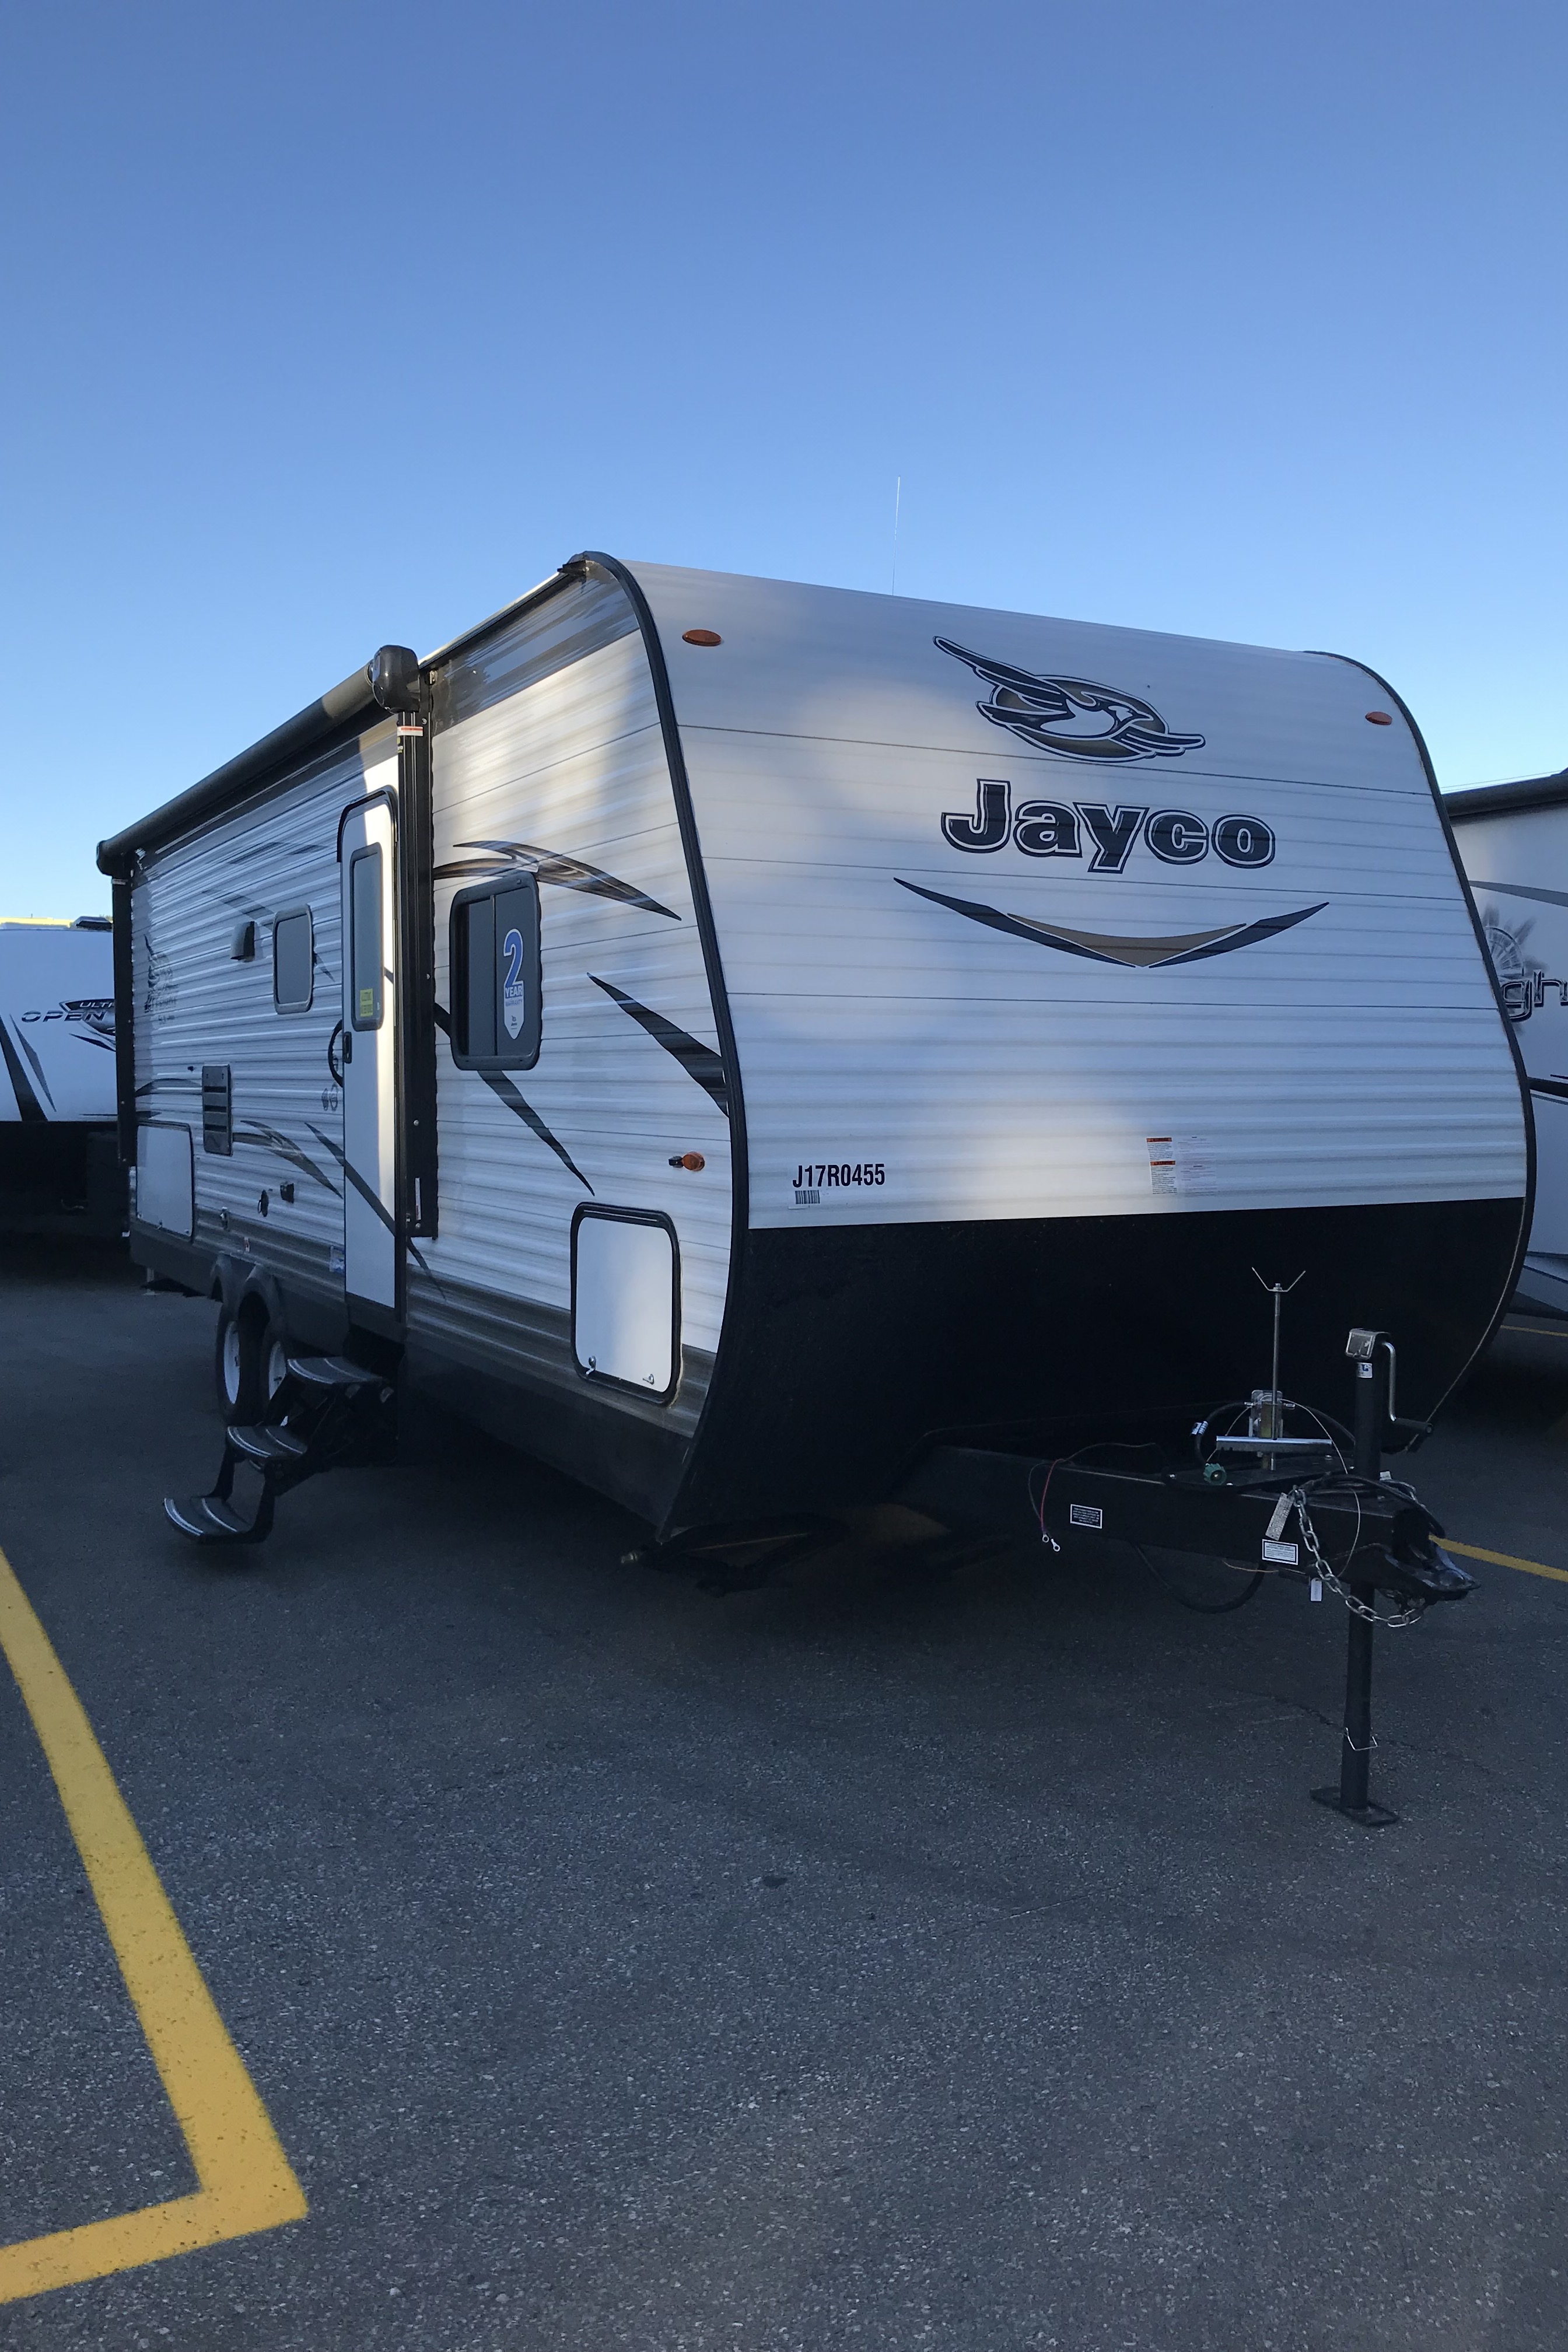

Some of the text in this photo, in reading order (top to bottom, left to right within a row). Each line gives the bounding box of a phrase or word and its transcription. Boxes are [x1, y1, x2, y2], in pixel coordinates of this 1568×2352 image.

[941, 779, 1275, 873] Jayco
[504, 929, 523, 988] 2
[505, 985, 523, 998] YEAR
[21, 1010, 107, 1023] OPEN
[792, 1164, 885, 1188] J17R0455
